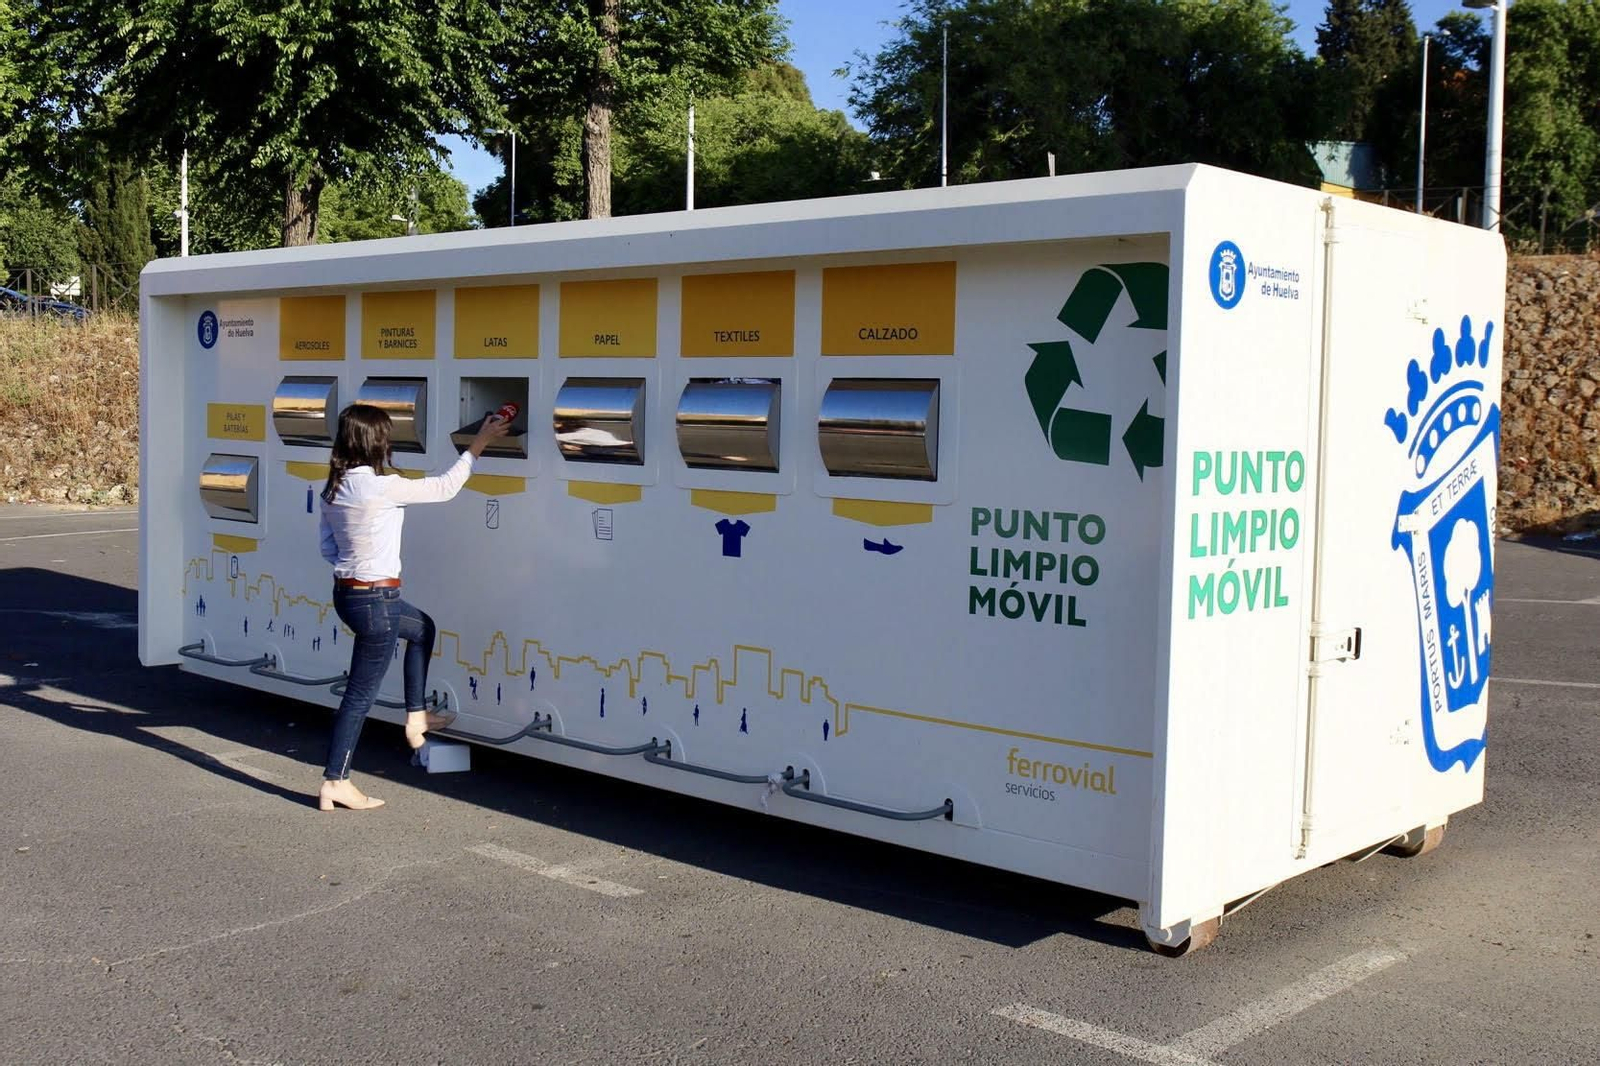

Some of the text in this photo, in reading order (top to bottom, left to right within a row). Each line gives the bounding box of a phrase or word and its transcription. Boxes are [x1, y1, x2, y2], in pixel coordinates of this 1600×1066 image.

[1248, 261, 1300, 283] Ayuntamiento
[1261, 281, 1299, 300] de Huelva
[219, 318, 254, 330] Ayuntamiento
[228, 328, 254, 338] de Huelva
[380, 327, 415, 338] PINTURAS
[858, 327, 918, 341] CALZADO
[294, 340, 330, 351] AEROSOLES
[378, 339, 418, 349] Y BARNICES
[484, 337, 508, 348] LATAS
[594, 334, 621, 346] PAPEL
[714, 330, 760, 343] TEXTILES
[1192, 450, 1305, 496] PUNTO
[1431, 492, 1443, 516] ET
[970, 507, 1106, 545] PUNTO
[1189, 507, 1300, 559] LIMPIO
[969, 547, 1100, 586] LIMPIO
[1187, 558, 1289, 620] MÓVIL
[968, 581, 1087, 628] MÓVIL
[1417, 551, 1443, 714] PORTUS MARIS
[1006, 747, 1117, 795] ferrovial
[1005, 782, 1056, 802] servicios
